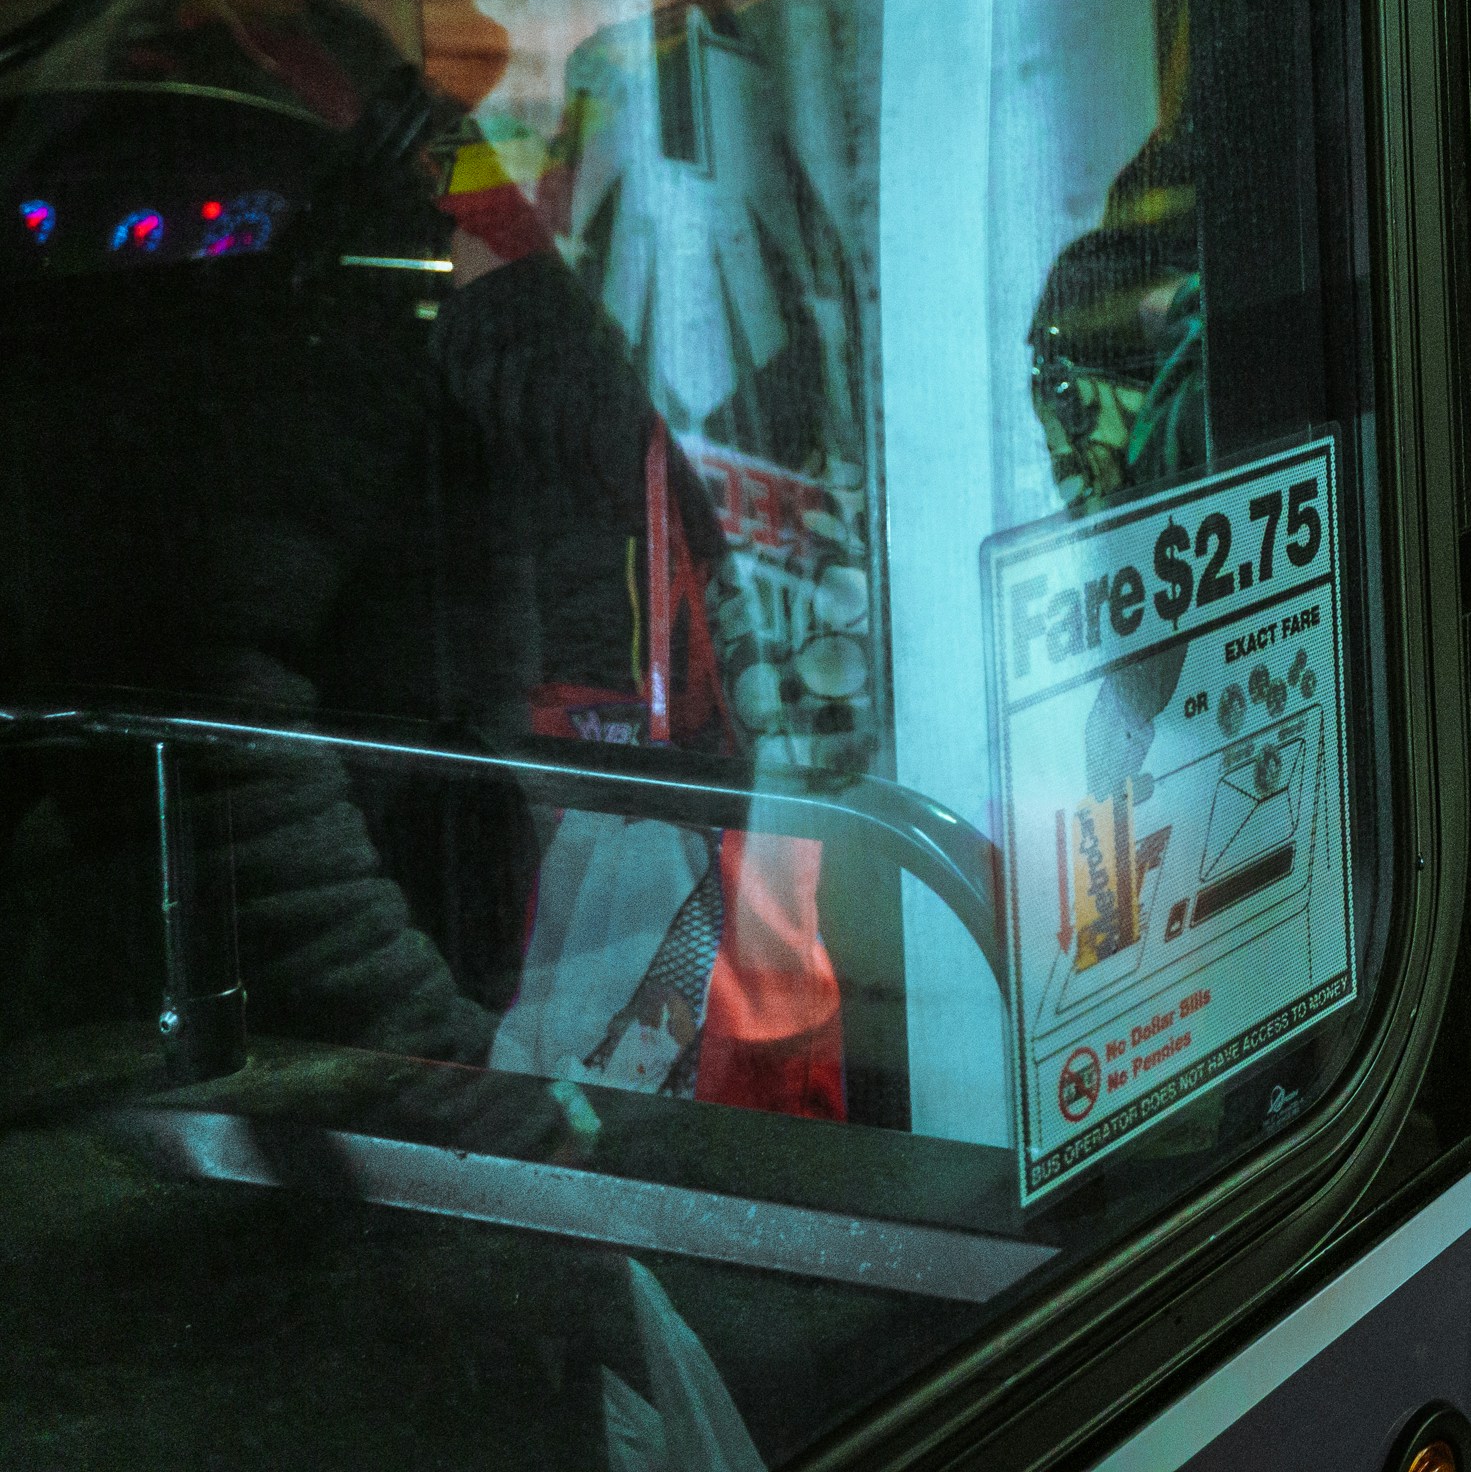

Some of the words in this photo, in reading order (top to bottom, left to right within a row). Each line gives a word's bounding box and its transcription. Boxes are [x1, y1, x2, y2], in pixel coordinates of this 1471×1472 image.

[1225, 624, 1277, 663] EXACT
[1281, 605, 1321, 639] FARE
[1184, 692, 1208, 720] OR
[1032, 1154, 1060, 1187] BUS
[1141, 1082, 1177, 1116] DOES
[1180, 1065, 1204, 1094] NOT
[1243, 1013, 1289, 1052] ACCESS
[1293, 1003, 1307, 1021] TO
